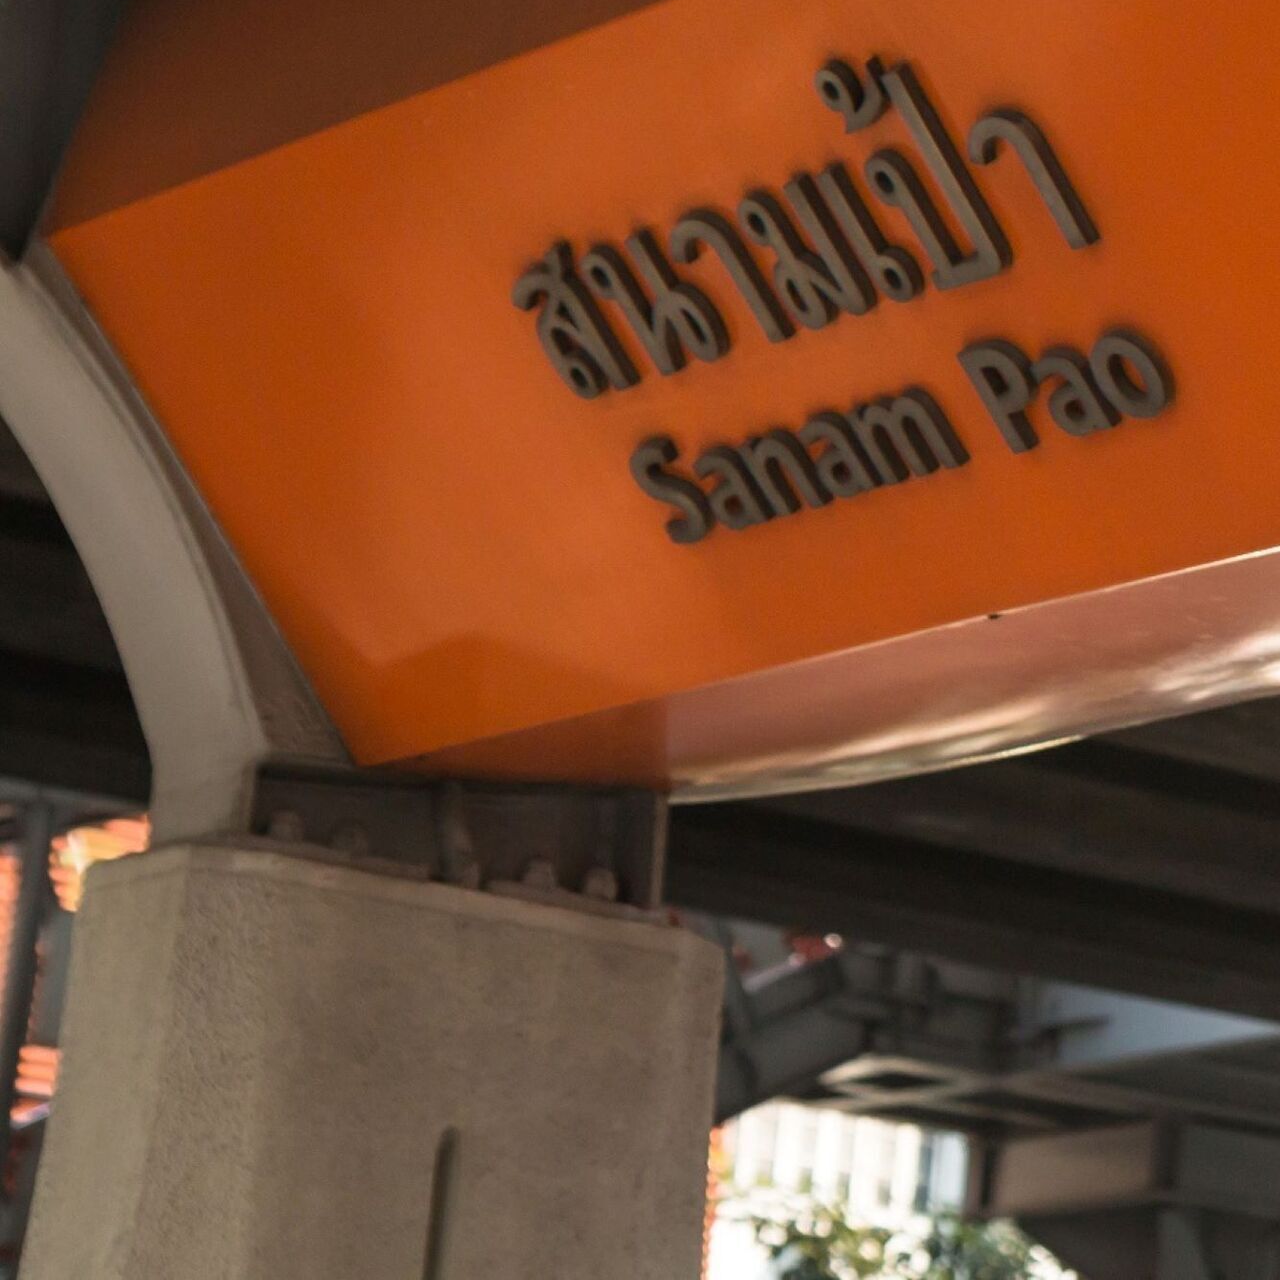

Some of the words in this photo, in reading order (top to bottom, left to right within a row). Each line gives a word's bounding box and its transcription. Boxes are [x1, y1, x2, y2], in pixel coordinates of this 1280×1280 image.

[513, 56, 1100, 400] สนามเป้า
[630, 385, 970, 544] Sanam
[958, 328, 1175, 455] Pao
